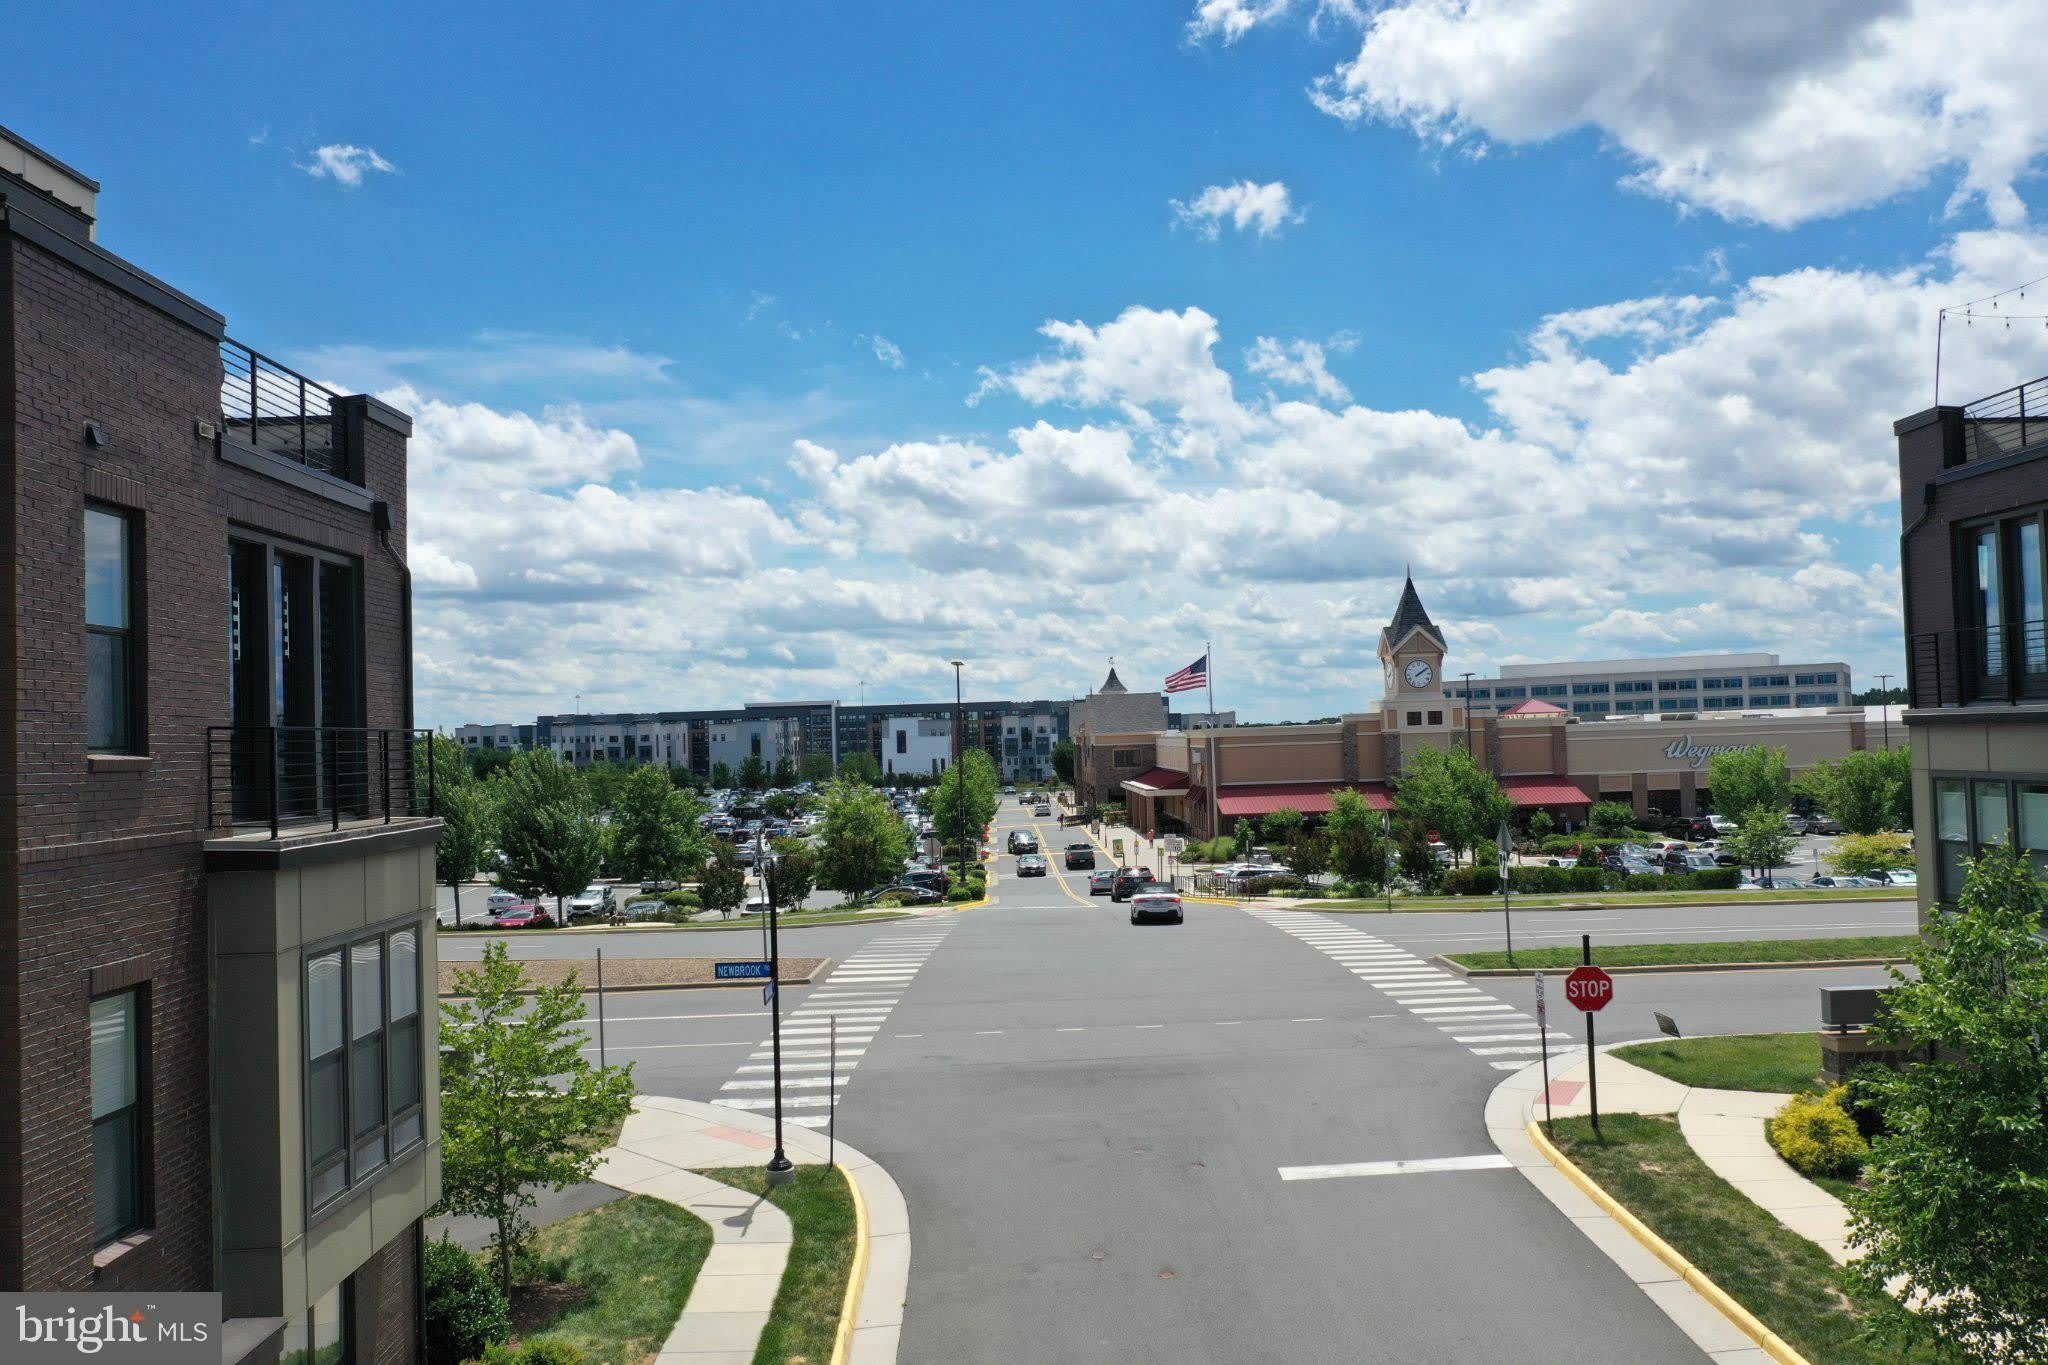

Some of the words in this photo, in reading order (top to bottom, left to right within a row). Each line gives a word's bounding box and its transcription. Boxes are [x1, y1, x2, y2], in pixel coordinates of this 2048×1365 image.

[1664, 734, 1759, 768] Wegman
[718, 965, 761, 977] NEWBROOK
[1569, 980, 1610, 998] STOP
